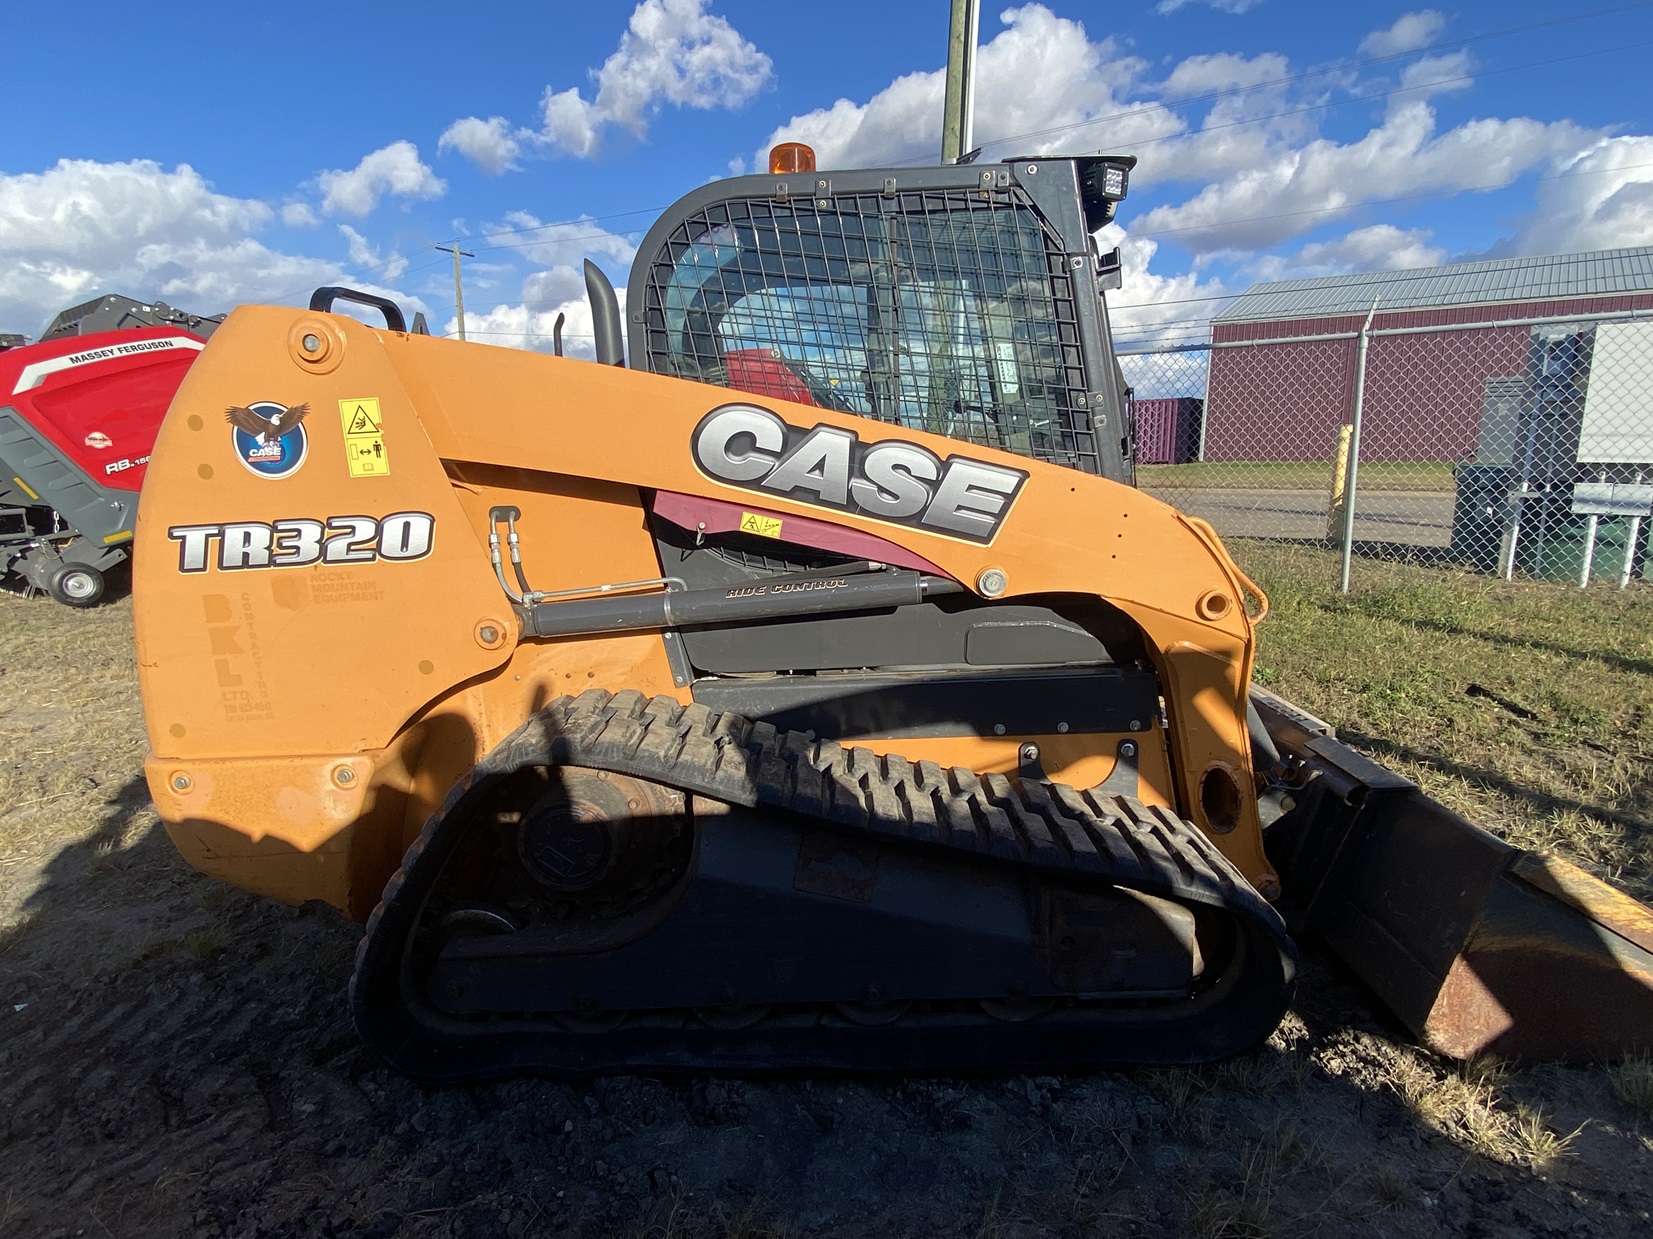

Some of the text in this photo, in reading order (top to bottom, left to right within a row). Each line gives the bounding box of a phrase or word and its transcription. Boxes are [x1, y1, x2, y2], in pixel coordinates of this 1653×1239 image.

[69, 340, 174, 365] MASSEY FERGUSON
[248, 445, 281, 457] CASE
[691, 403, 1028, 544] CASE
[168, 511, 435, 574] TR320
[309, 571, 353, 583] ROCKY
[311, 580, 377, 593] MOUNTAIN
[725, 578, 849, 599] RIDE CONTROL
[312, 590, 386, 604] EQUIPMENT
